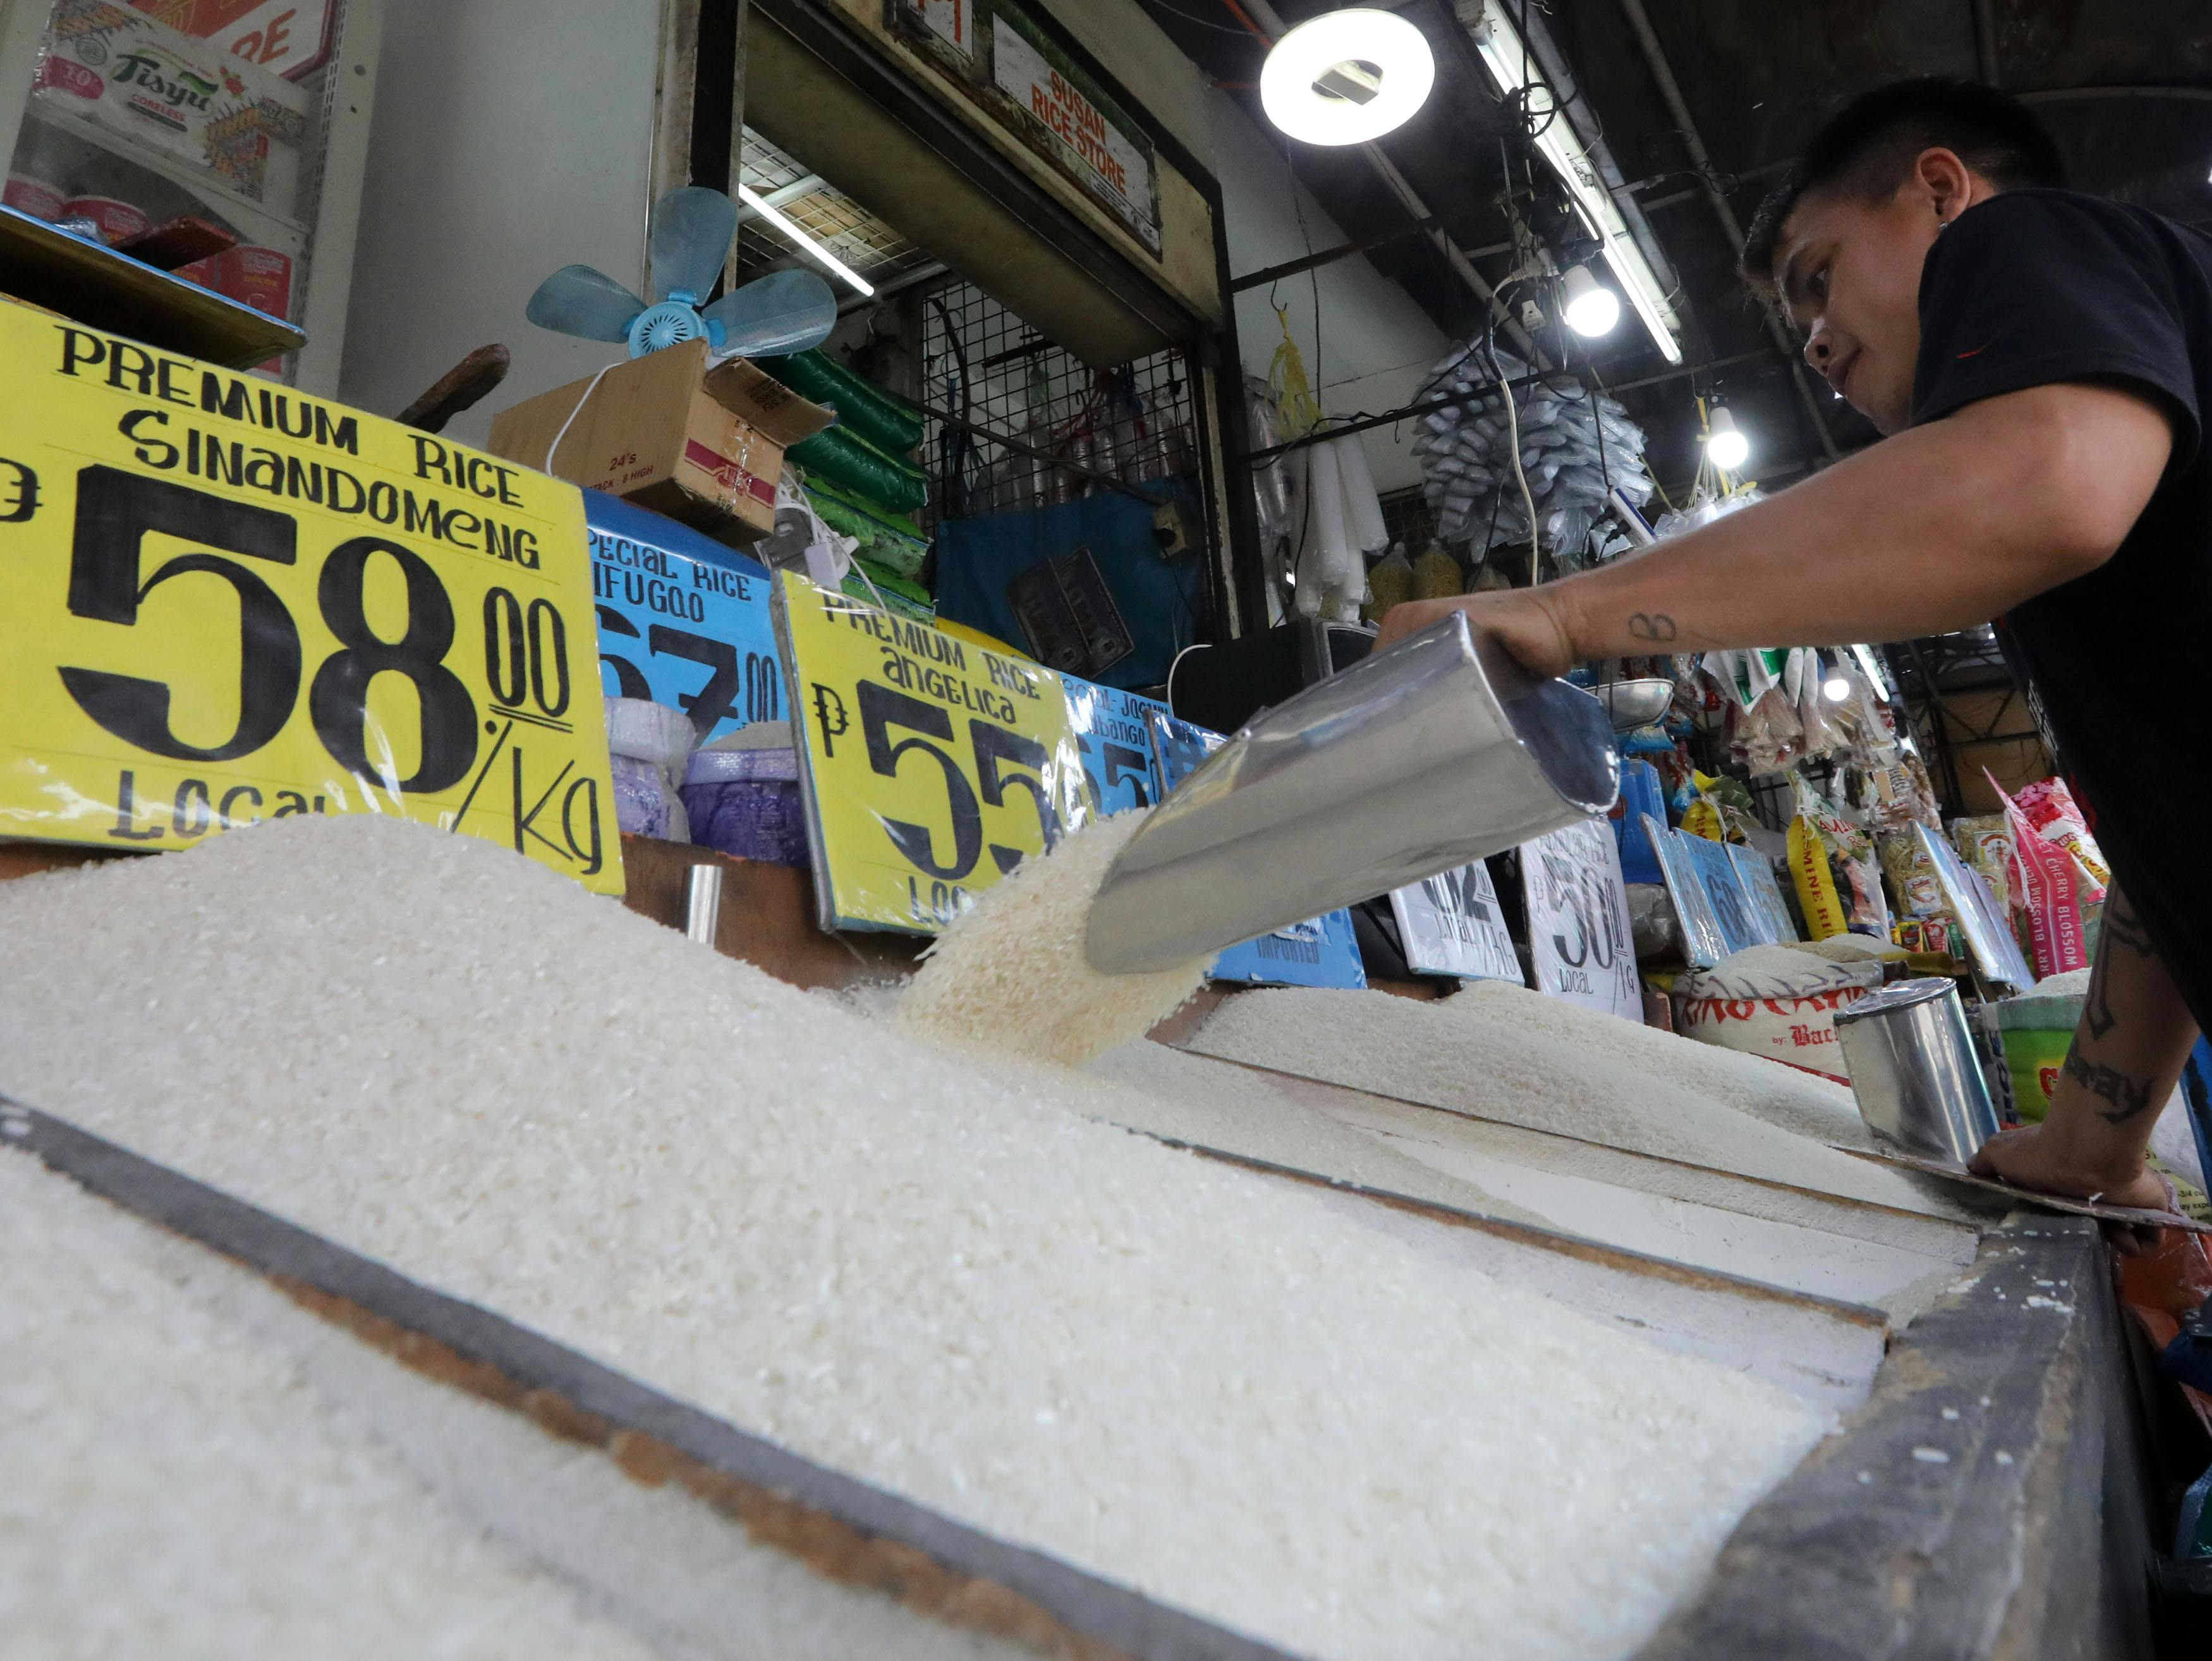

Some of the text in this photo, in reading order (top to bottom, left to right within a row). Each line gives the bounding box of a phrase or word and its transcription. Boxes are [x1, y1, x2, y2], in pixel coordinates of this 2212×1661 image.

[112, 54, 210, 112] Tisyu
[131, 94, 185, 121] CORELESS
[1050, 70, 1106, 147] SUSAN
[1031, 83, 1074, 145] RICE
[1074, 125, 1126, 197] STORE
[53, 325, 525, 508] PREMIUM RICE
[590, 478, 614, 491] TACK
[631, 465, 653, 481] HIGH
[693, 561, 751, 602] RICE
[823, 593, 966, 672] PREMIUM
[981, 652, 1042, 700] RICE
[856, 679, 1066, 881] 55
[1541, 853, 1613, 970] 50
[2045, 858, 2069, 900] CHERRY
[2057, 906, 2077, 966] BLOSSOM
[1772, 1036, 1787, 1044] by:
